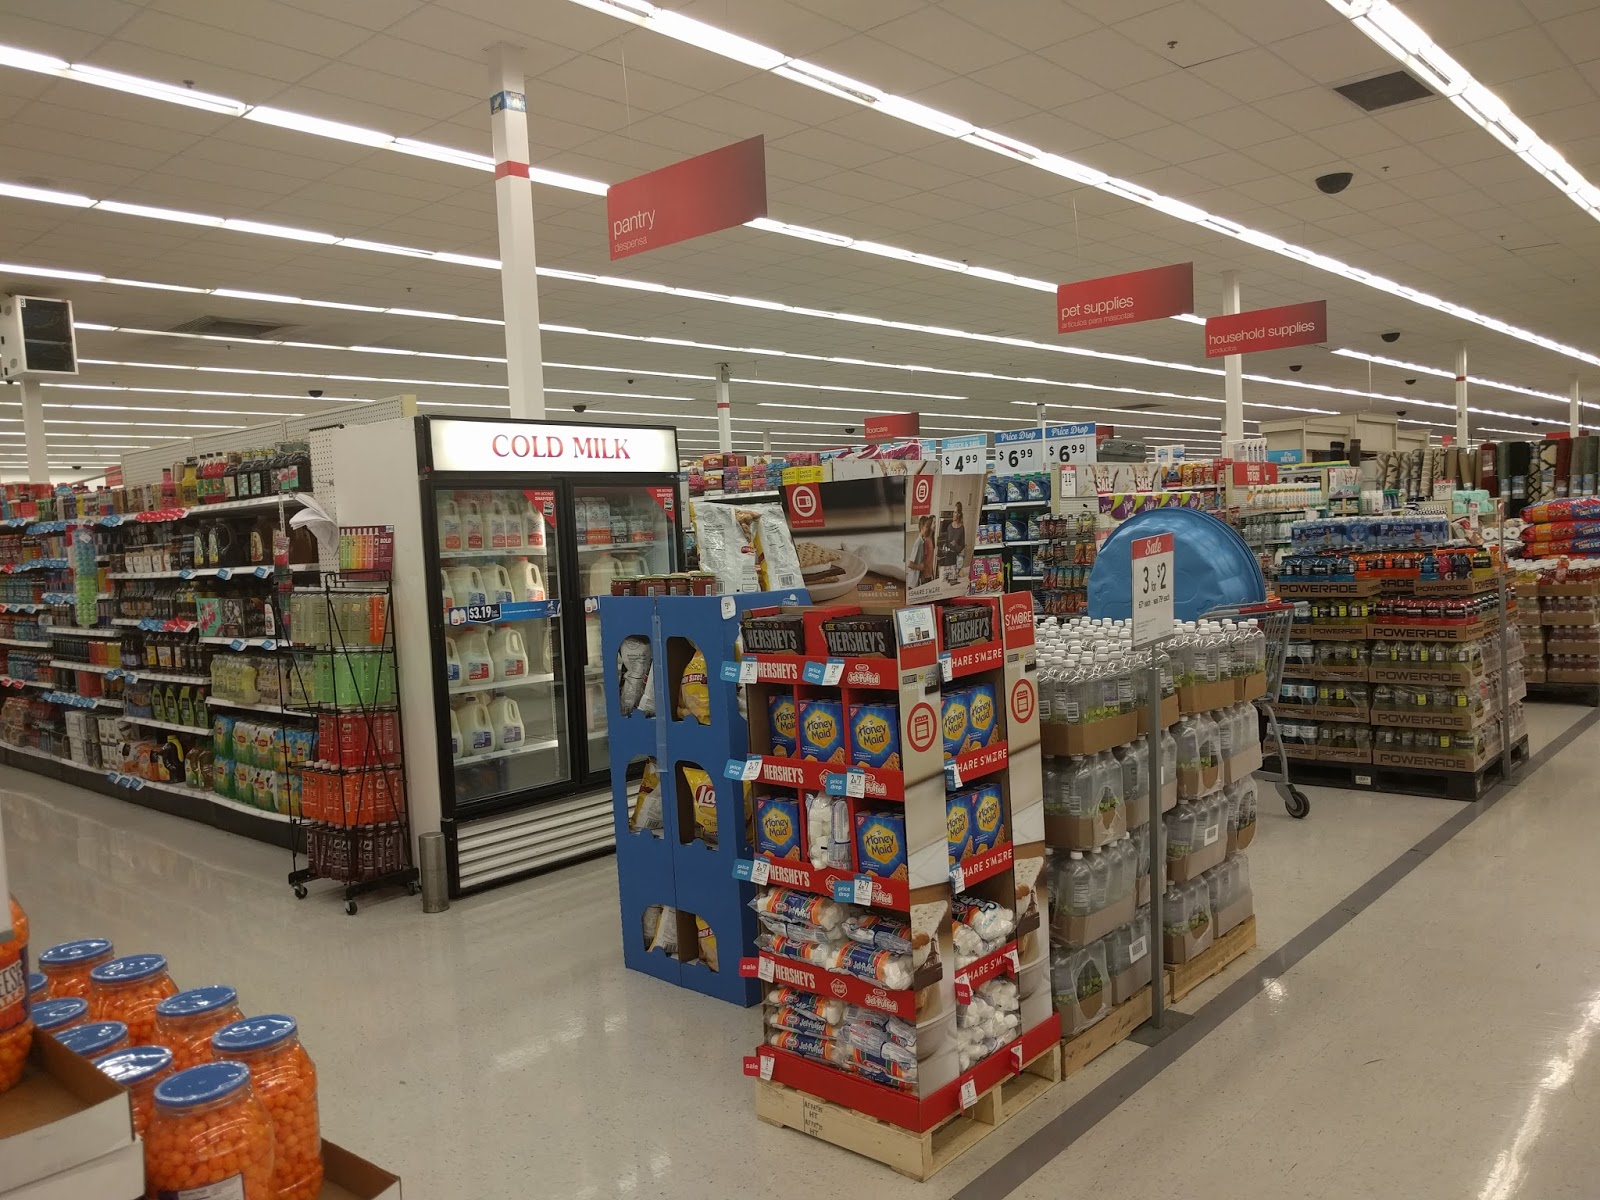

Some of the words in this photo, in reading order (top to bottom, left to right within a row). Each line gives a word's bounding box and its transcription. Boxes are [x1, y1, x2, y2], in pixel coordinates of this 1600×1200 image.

[613, 209, 656, 240] pantry
[614, 236, 648, 253] despensa
[1061, 305, 1081, 320] pet
[1083, 296, 1134, 314] supplies
[1088, 317, 1103, 327] para
[1103, 311, 1135, 323] mascotas
[1209, 327, 1265, 345] household
[1268, 321, 1315, 338] supplies
[1001, 432, 1018, 442] Price
[1019, 431, 1036, 441] Drop
[1051, 427, 1069, 436] Price
[1070, 425, 1089, 435] Drop
[491, 434, 564, 458] COLD
[572, 436, 631, 460] MILK
[1145, 537, 1162, 556] Sale
[1143, 566, 1149, 594] 3
[1381, 579, 1414, 588] RADE
[1279, 585, 1358, 593] POWERADE
[1416, 584, 1468, 592] POWERADE
[469, 605, 492, 619] $3.19
[950, 617, 990, 643] HERSHEY'S
[1374, 628, 1457, 639] POWERADE
[746, 629, 797, 650] HERSHEY'S
[828, 631, 886, 653] HERSHEY'S
[952, 654, 973, 668] HARE
[757, 662, 798, 680] HERSHEY'S
[808, 667, 821, 675] price
[808, 672, 820, 680] drop
[1376, 671, 1461, 682] POWERADE
[848, 672, 880, 685] Jet-Puffed
[971, 700, 991, 716] Honey
[775, 711, 795, 723] Hone
[944, 709, 965, 726] Honey
[975, 711, 991, 723] Maid
[1377, 714, 1463, 727] POWERADE
[806, 719, 833, 732] Honey
[857, 723, 886, 737] Honey
[947, 720, 963, 734] Maid
[811, 728, 831, 741] Maid
[863, 733, 884, 746] Maid
[957, 760, 978, 773] HARE
[1380, 753, 1466, 769] POWERADE
[763, 764, 803, 784] HERSHEY'S
[830, 778, 843, 786] price
[830, 783, 842, 791] drop
[865, 781, 887, 796] Puffed
[978, 801, 997, 819] Honey
[765, 818, 789, 829] Honey
[946, 812, 966, 831] Honey
[982, 812, 997, 827] Maid
[769, 826, 788, 837] Maid
[950, 823, 965, 839] Maid
[865, 834, 894, 847] Honey
[871, 843, 893, 855] Maid
[962, 860, 983, 878] HARE
[769, 865, 810, 888] HERSHEY'S
[872, 890, 894, 905] Puffed
[775, 964, 816, 989] HERSHEY'S
[967, 963, 989, 981] HARE
[865, 994, 898, 1012] Jet-Puffed
[799, 1041, 824, 1055] Jet-Puffed
[745, 1062, 758, 1070] sale
[809, 1110, 818, 1119] HT
[810, 1128, 819, 1136] HT
